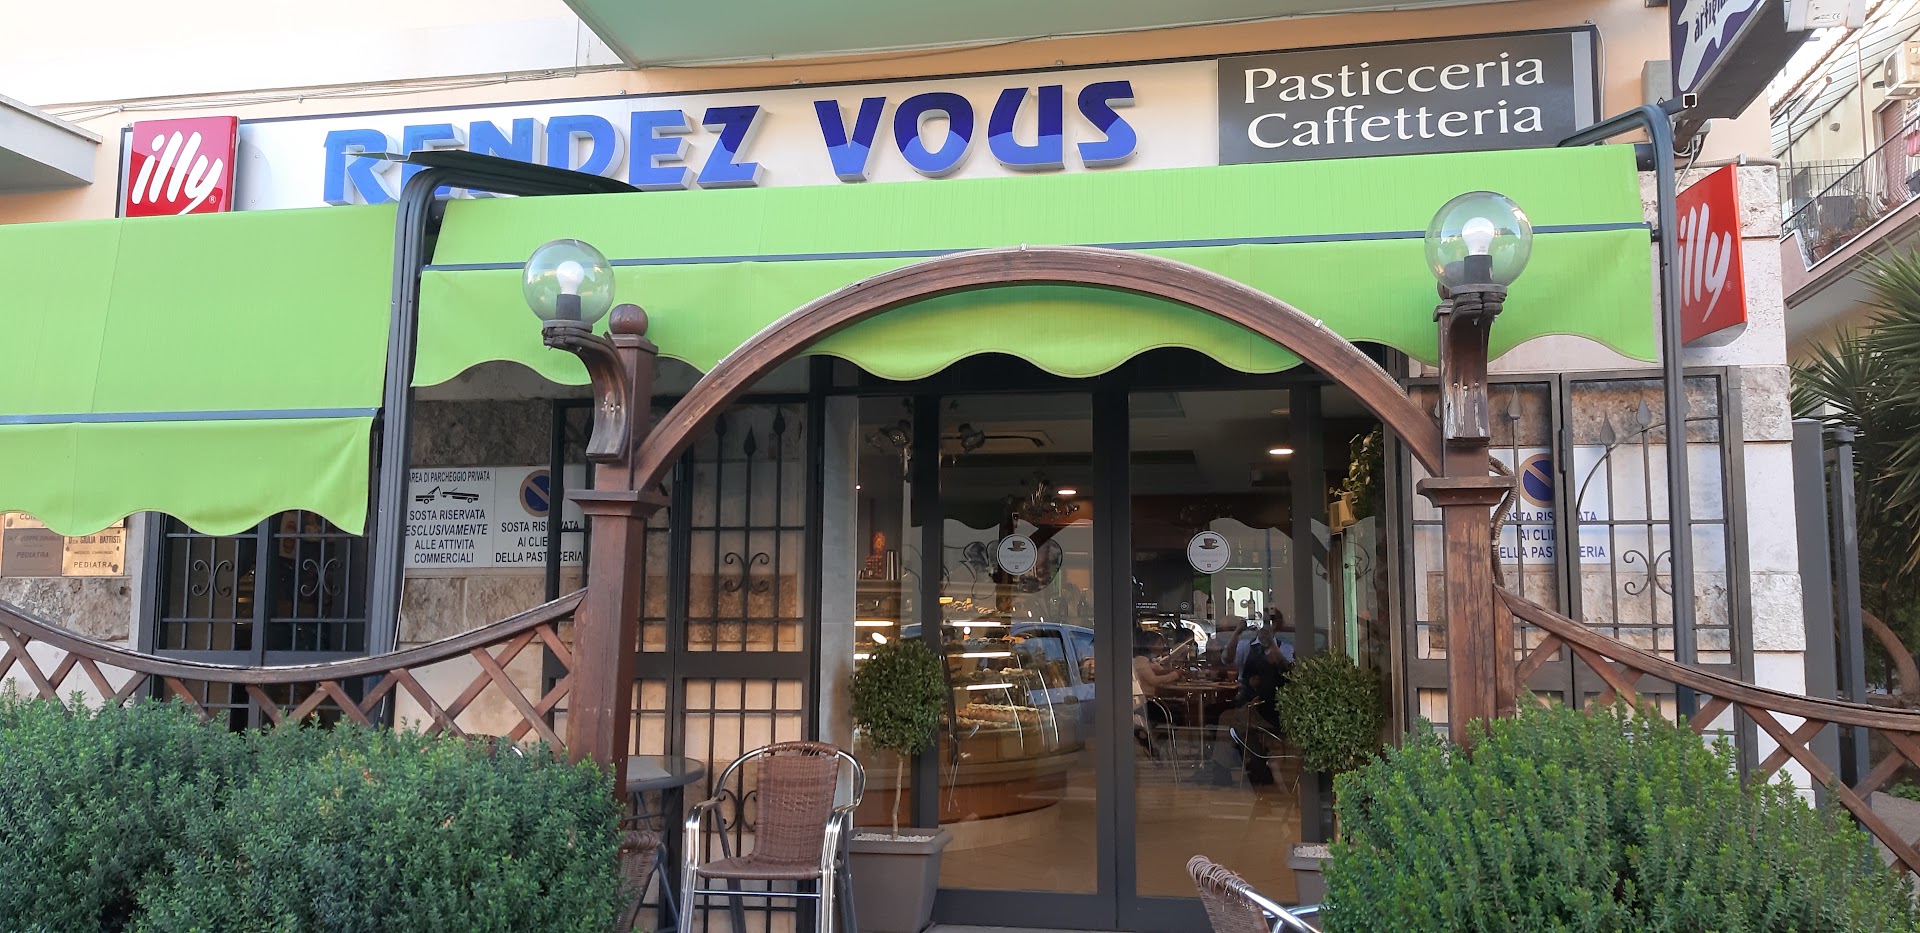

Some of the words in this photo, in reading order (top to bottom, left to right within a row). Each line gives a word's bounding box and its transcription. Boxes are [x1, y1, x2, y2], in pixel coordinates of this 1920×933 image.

[1244, 51, 1545, 103] Pasticceria
[1247, 100, 1543, 149] Caffetteria
[813, 80, 1137, 183] VOUS
[131, 130, 224, 215] illy
[1678, 202, 1732, 323] illy
[431, 471, 467, 482] PARCHEGGIO
[467, 470, 491, 482] PRIVATA
[409, 510, 437, 521] SOSTA
[439, 509, 486, 520] RISERVATA
[405, 523, 488, 537] ESCLUSIVAMENTE
[501, 521, 530, 533] SOSTA
[532, 520, 579, 532] RISATA
[414, 539, 437, 550] ALLE
[517, 536, 527, 547] AI
[16, 551, 50, 559] PEDIATRA
[414, 552, 474, 563] COMMERCIALI
[495, 552, 524, 563] DELLA
[1499, 547, 1528, 559] ELLA
